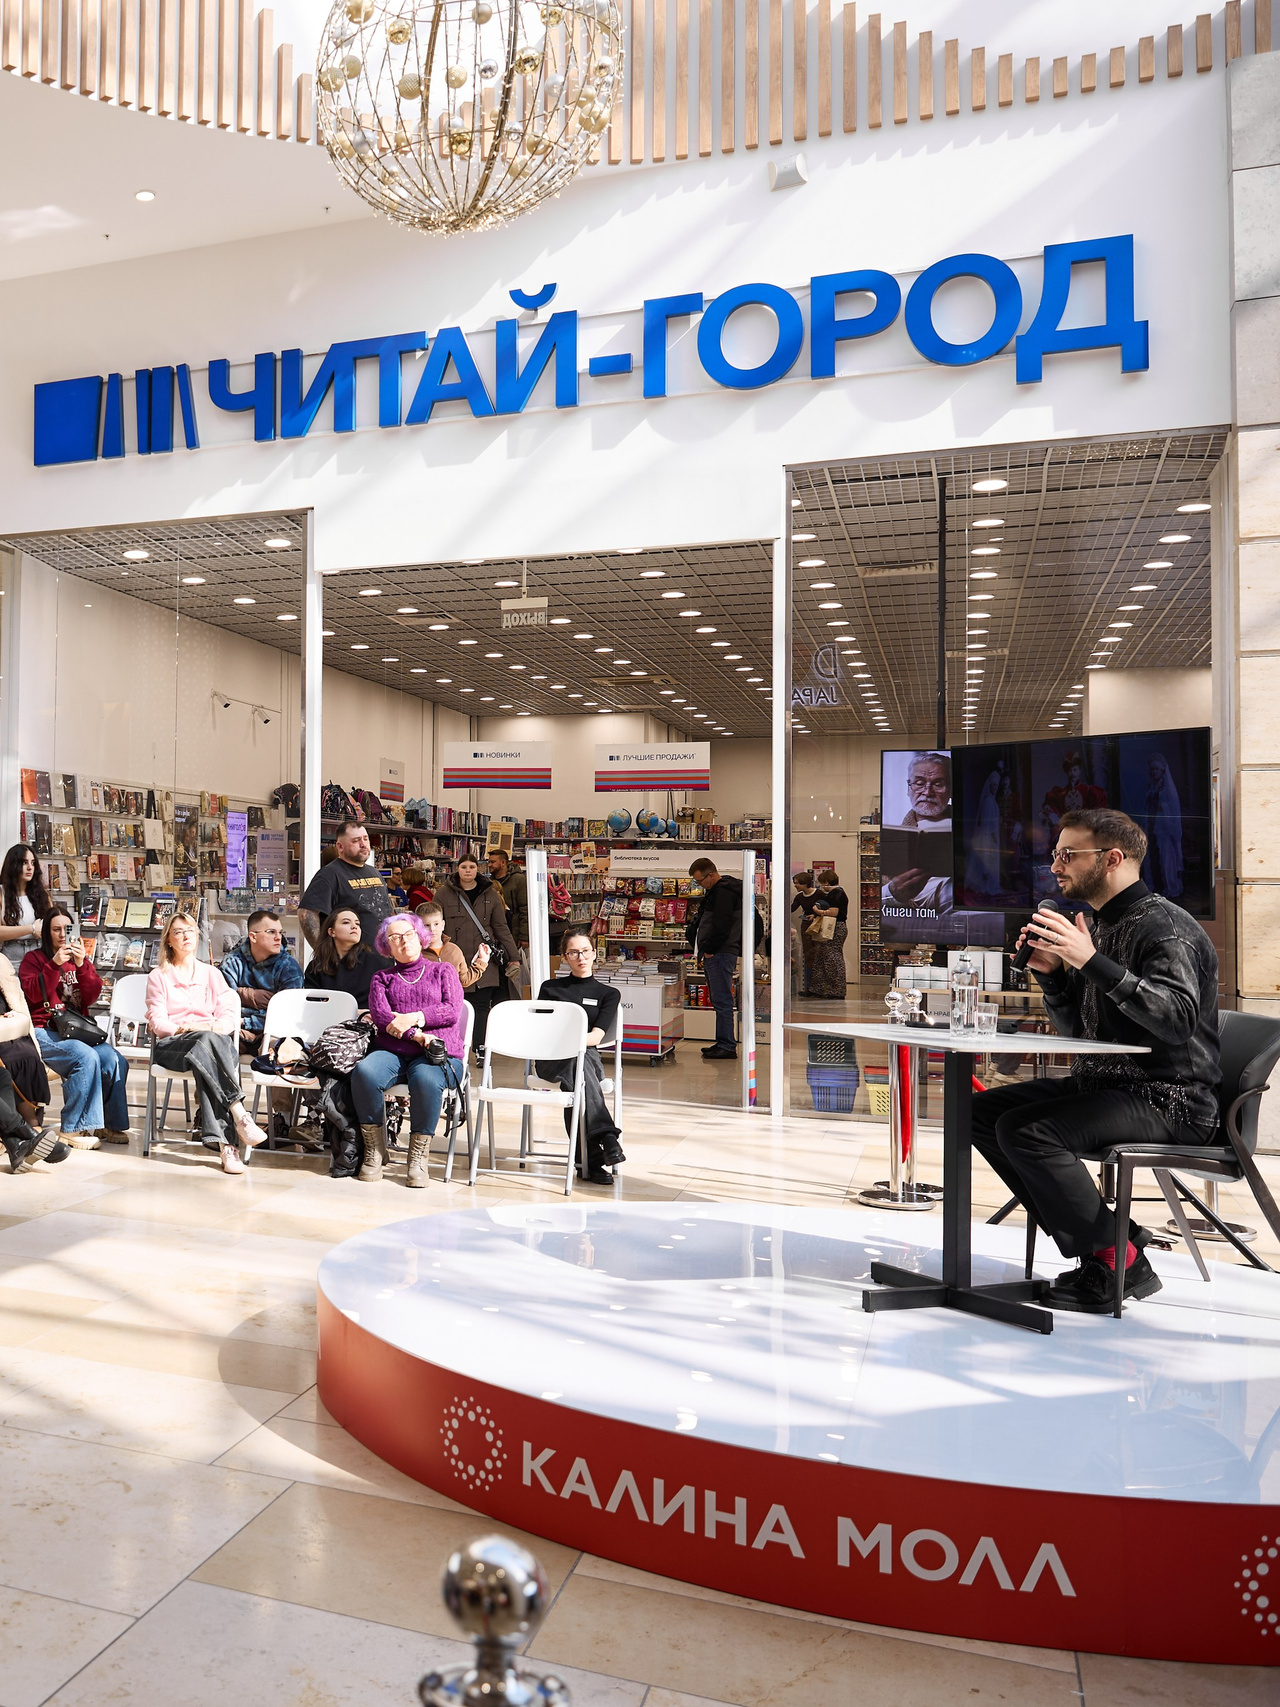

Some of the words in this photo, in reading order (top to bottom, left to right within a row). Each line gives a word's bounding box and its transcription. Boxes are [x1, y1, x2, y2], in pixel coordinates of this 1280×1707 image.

[208, 233, 1150, 442] ЧИТАЙ-ГОРОД
[522, 1440, 806, 1560] КАЛИНА
[837, 1515, 1077, 1598] МОЛЛ
